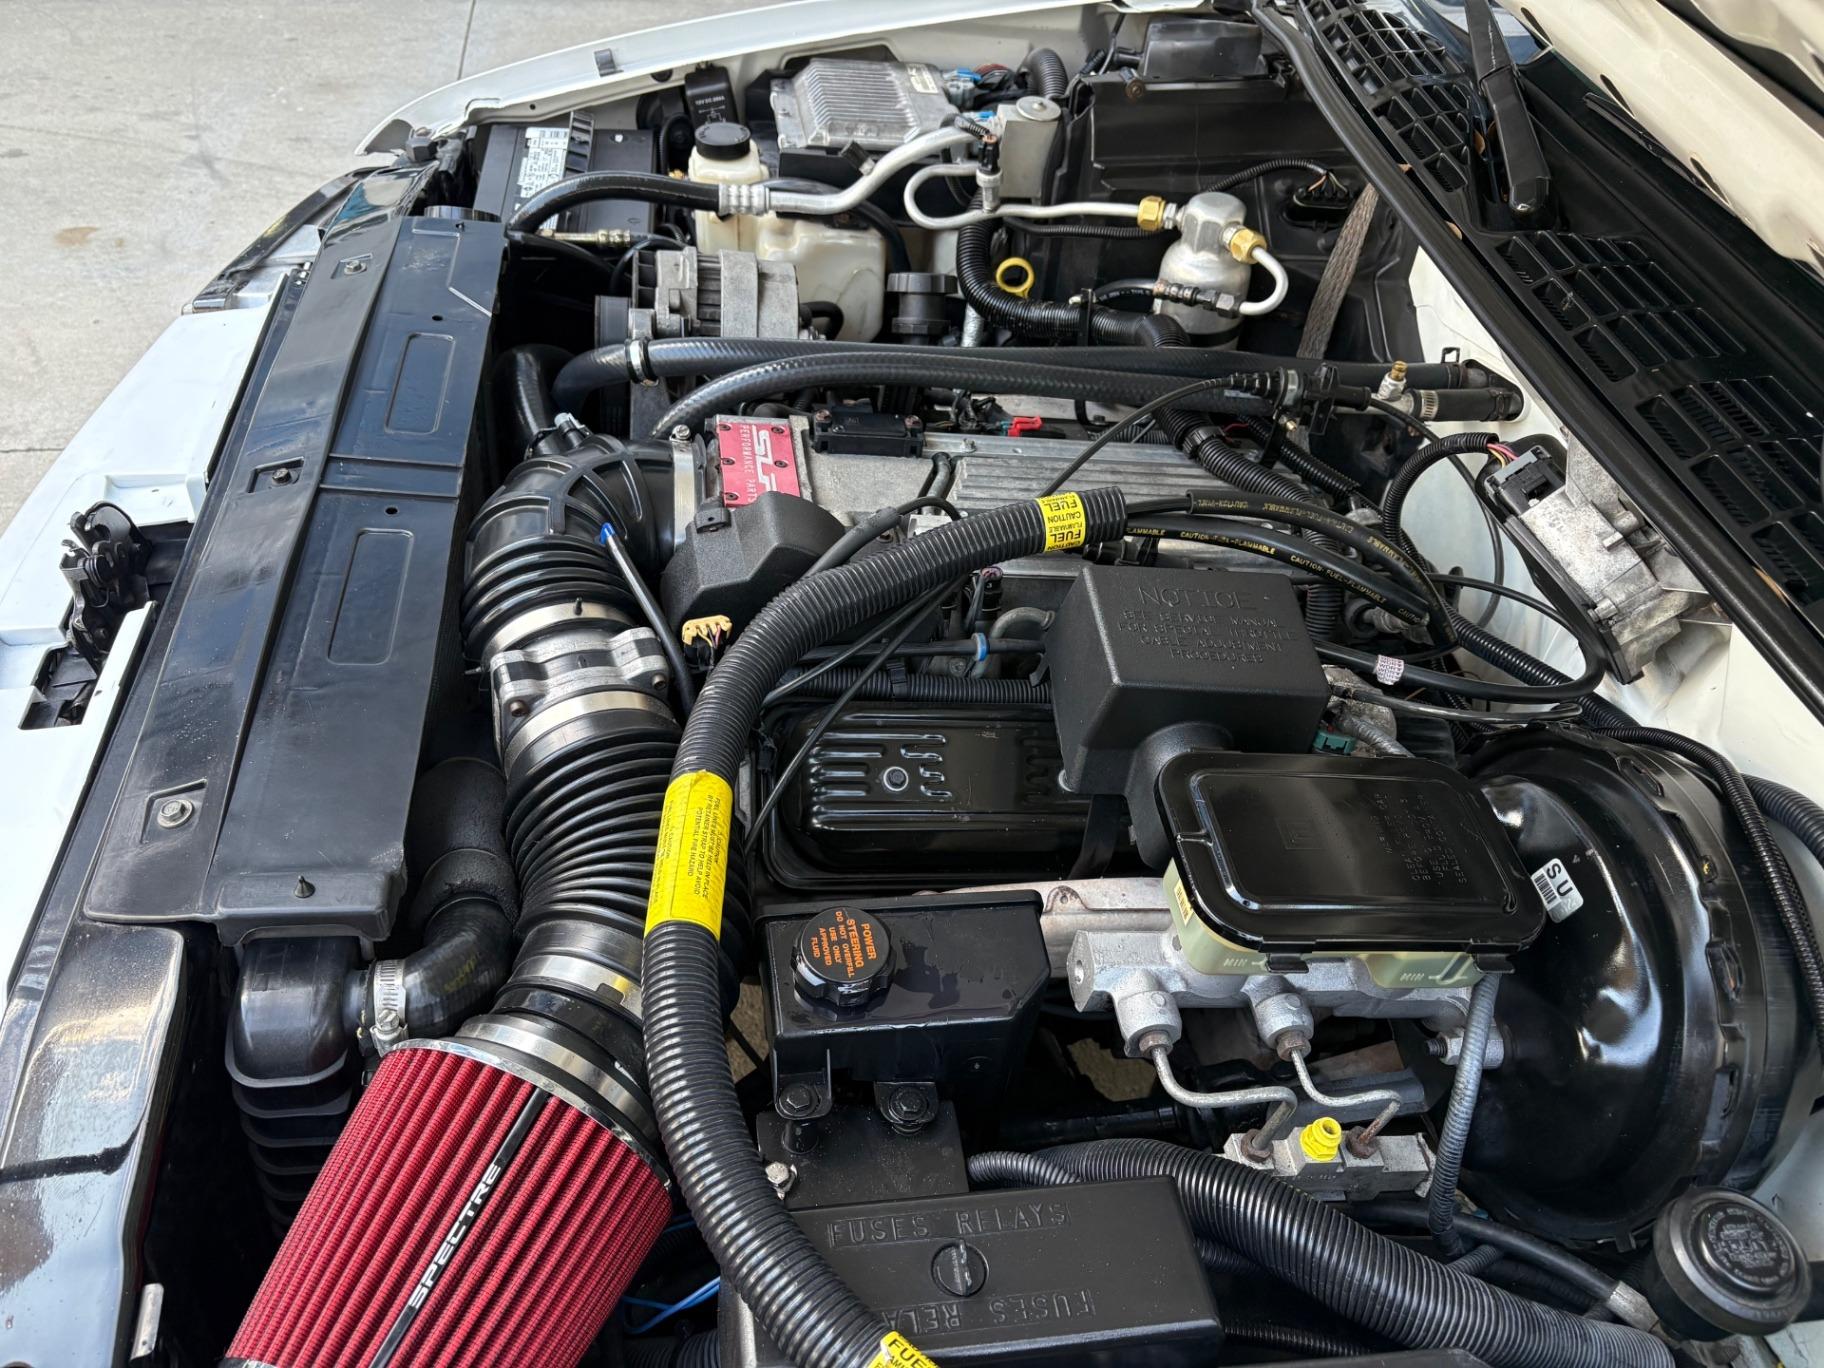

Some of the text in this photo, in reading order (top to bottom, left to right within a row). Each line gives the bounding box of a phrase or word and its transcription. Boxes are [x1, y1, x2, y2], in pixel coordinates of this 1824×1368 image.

[741, 425, 758, 503] PERFORMANCE PARTS
[1044, 499, 1078, 512] FUEL
[1048, 511, 1080, 524] CAUTION
[1050, 530, 1082, 543] FUEL
[1138, 586, 1256, 609] NOTICE
[693, 808, 703, 836] POTENTIAL
[702, 804, 712, 830] RETAINER
[811, 937, 820, 958] FLUID
[819, 928, 832, 966] APPROVED
[828, 926, 842, 964] USE ONLY
[836, 911, 855, 978] DO NOT OVERFILL
[846, 918, 864, 968] STEERING
[861, 923, 877, 960] POWER
[408, 1163, 501, 1309] SPECTRE
[830, 1203, 1067, 1247] FUSES RELAYS
[881, 1290, 1094, 1335] FUSES RELA
[888, 1338, 930, 1368] FUE
